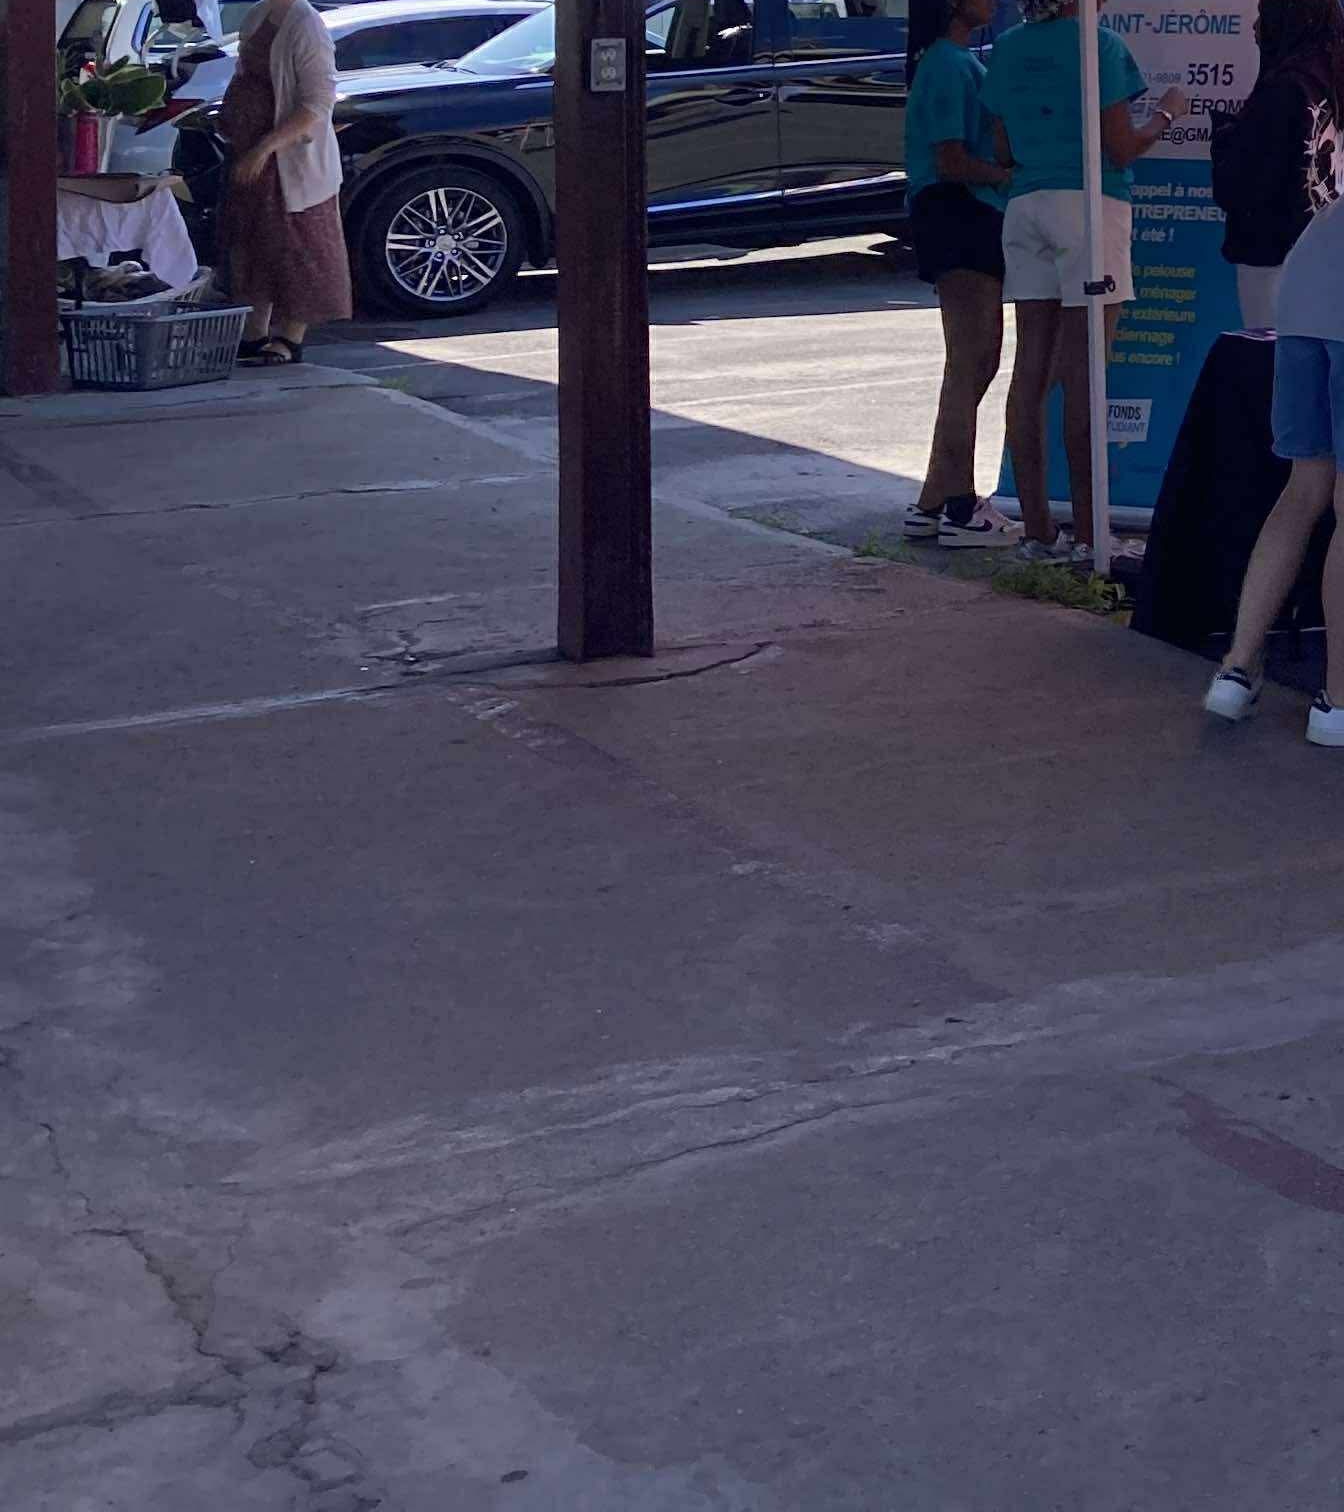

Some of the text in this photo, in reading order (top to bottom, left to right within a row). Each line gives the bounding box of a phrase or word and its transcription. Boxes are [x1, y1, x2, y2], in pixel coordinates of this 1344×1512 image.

[1099, 8, 1241, 35] AINT-JÉRÔME
[1132, 204, 1227, 223] TREPRENEU
[1108, 404, 1141, 421] FONDS
